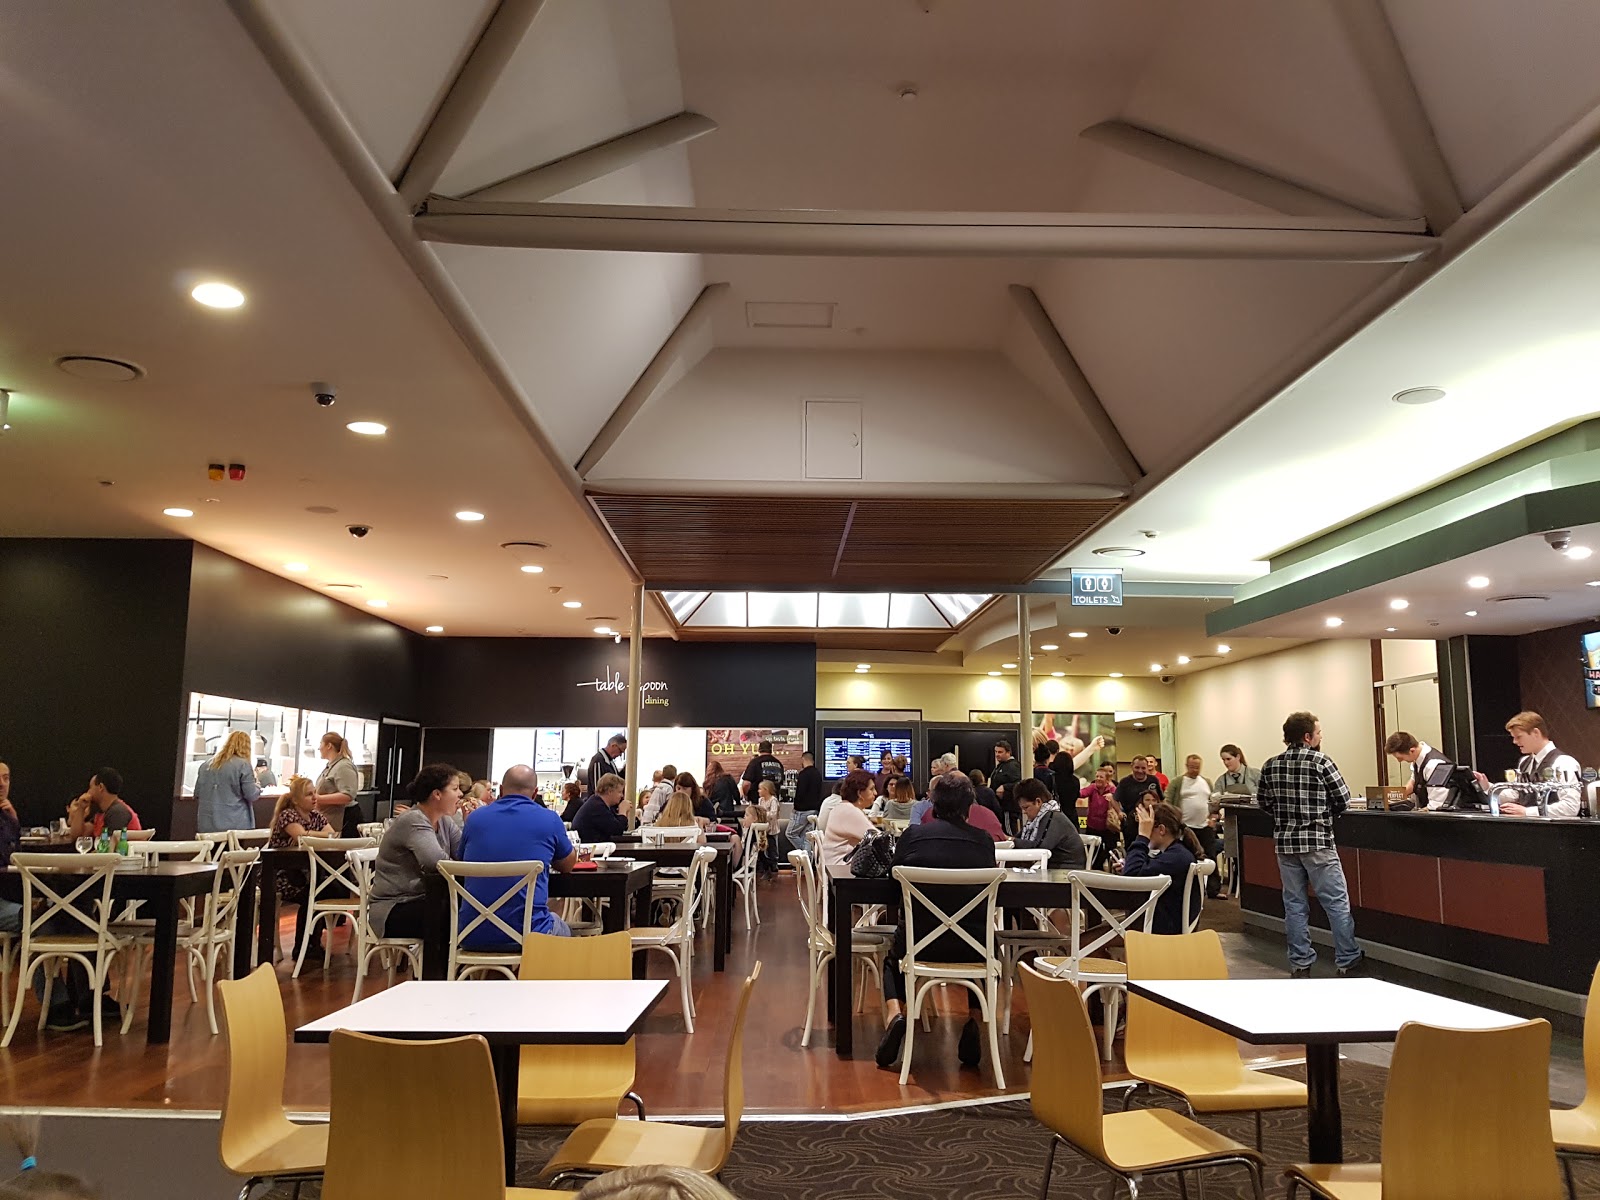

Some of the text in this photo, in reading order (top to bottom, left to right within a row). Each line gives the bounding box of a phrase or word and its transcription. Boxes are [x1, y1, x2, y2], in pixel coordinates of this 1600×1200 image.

[1074, 596, 1109, 604] TOILETS
[645, 694, 669, 707] dining
[711, 743, 790, 755] OH YU...
